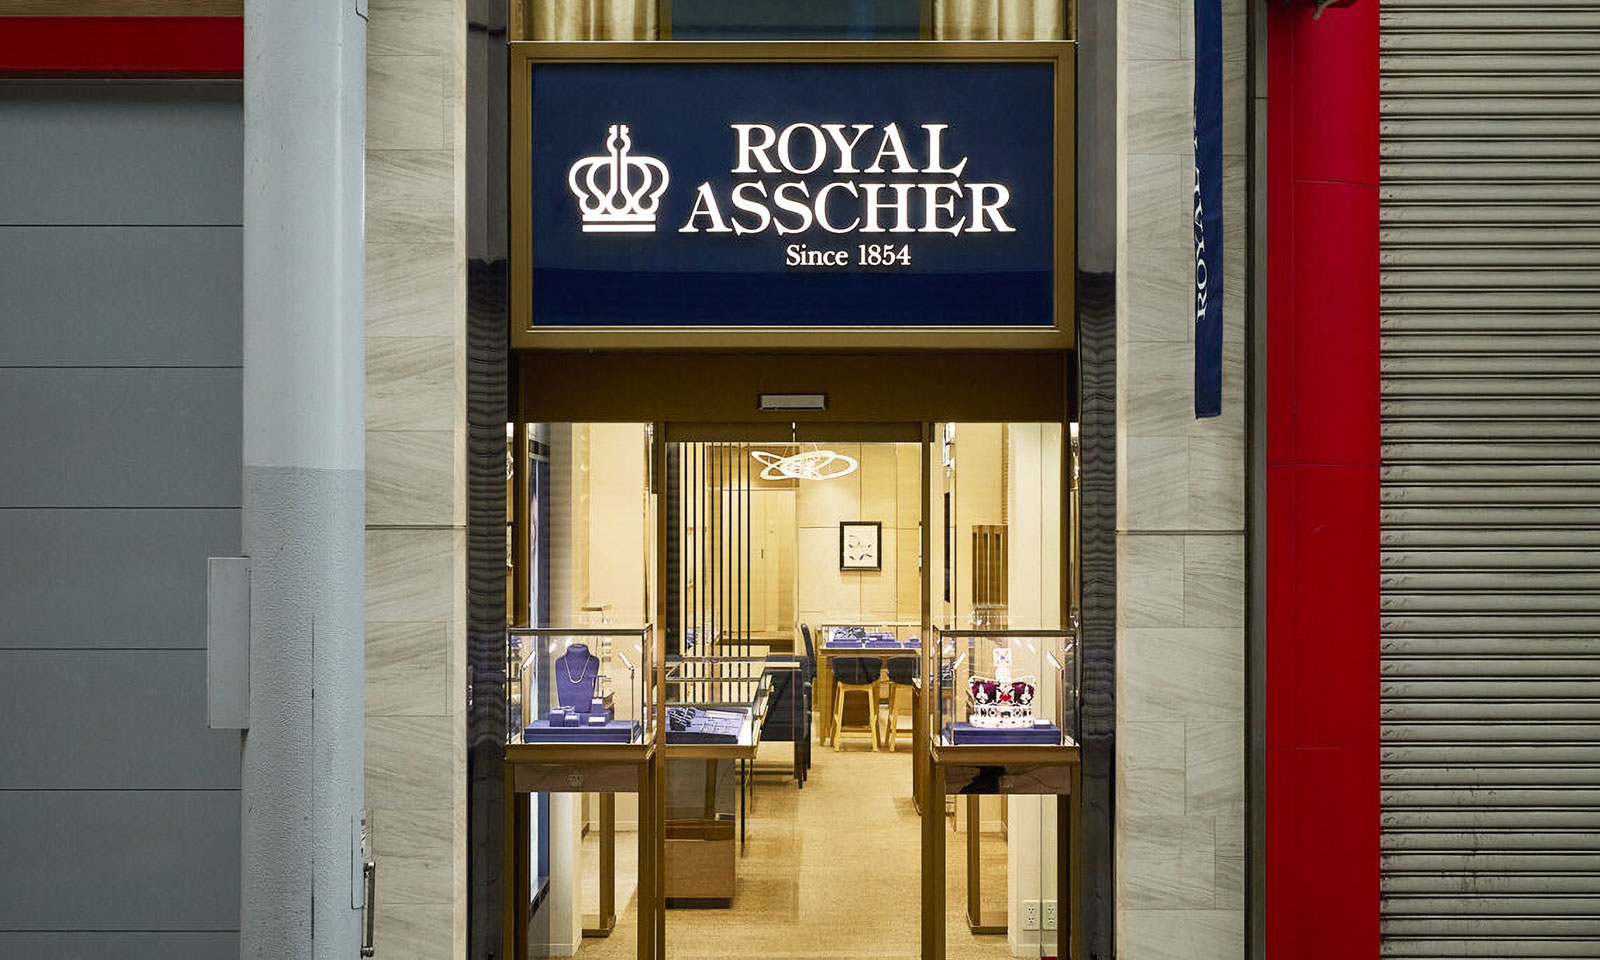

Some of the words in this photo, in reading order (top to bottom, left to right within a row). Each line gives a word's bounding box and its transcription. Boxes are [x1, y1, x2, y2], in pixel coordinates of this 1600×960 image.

[731, 122, 967, 178] ROYAL
[678, 182, 1016, 236] ASSCHER
[786, 244, 849, 266] Since
[858, 244, 911, 266] 1854
